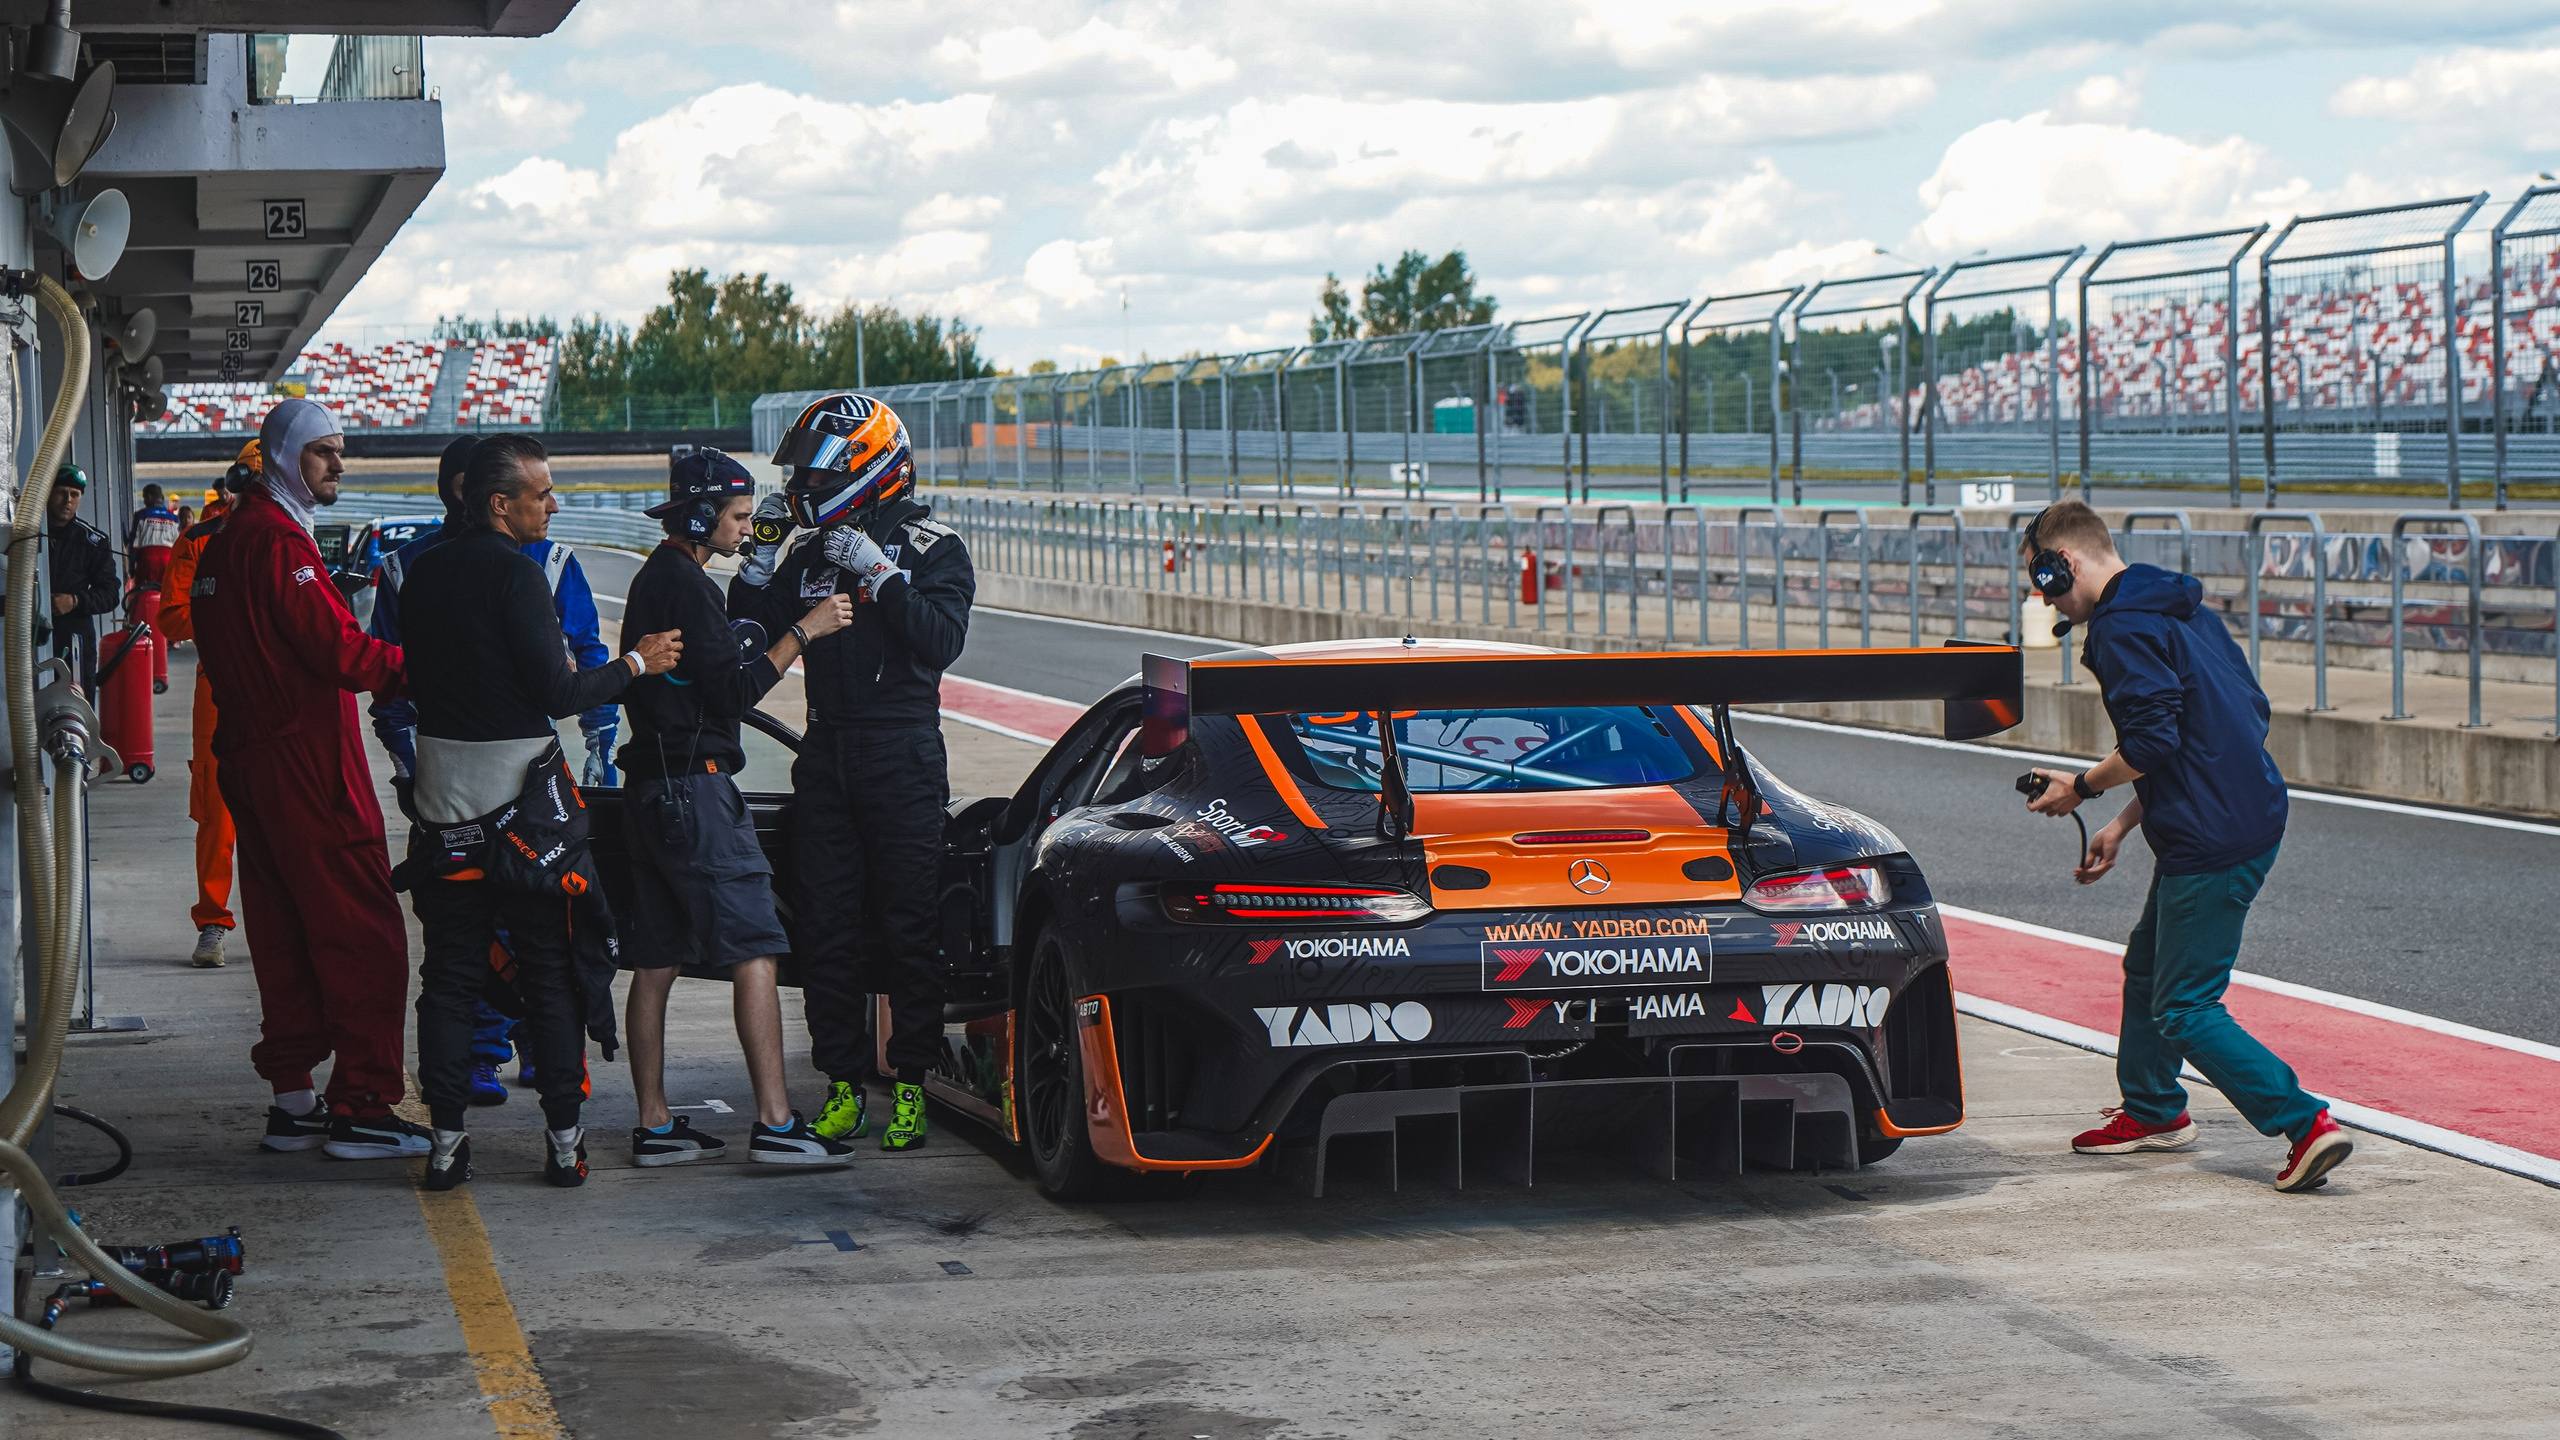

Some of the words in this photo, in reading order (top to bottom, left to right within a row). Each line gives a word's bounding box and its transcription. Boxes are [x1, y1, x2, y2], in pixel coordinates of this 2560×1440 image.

[268, 205, 302, 234] 25
[250, 265, 278, 288] 26
[238, 305, 261, 324] 27
[229, 332, 248, 349] 28
[223, 355, 241, 369] 29
[1976, 484, 2002, 503] 50
[383, 526, 417, 540] 12
[840, 532, 857, 562] freem
[495, 805, 518, 829] HRX
[1196, 798, 1247, 835] Sport
[540, 841, 567, 868] HRX
[1166, 840, 1195, 863] ACADEMY
[1802, 921, 1895, 942] YOKOHAMA
[1284, 937, 1411, 959] YOKOHAMA
[1544, 946, 1703, 977] YOKOHAMA
[1761, 983, 1892, 1028] YADRO
[1253, 1001, 1433, 1047] YADRO
